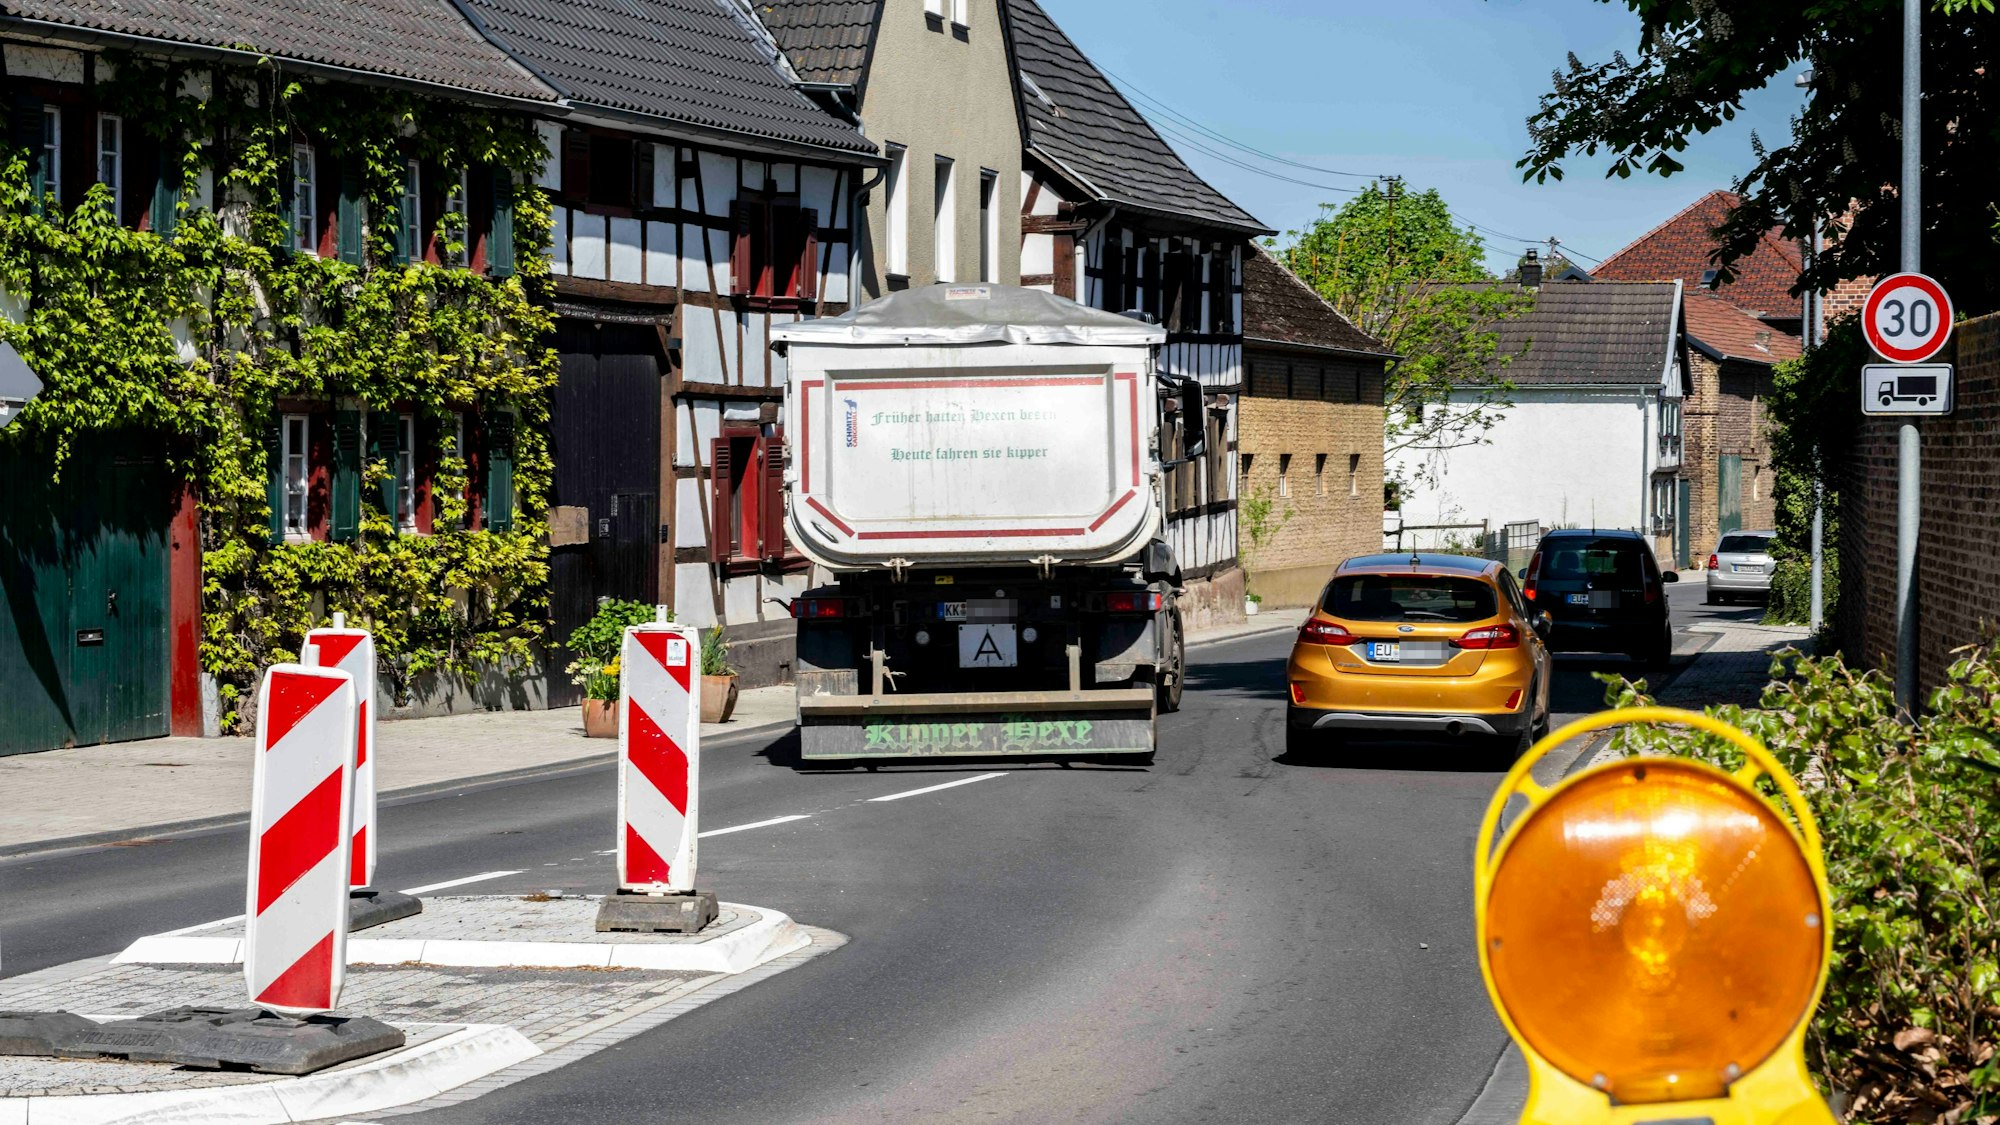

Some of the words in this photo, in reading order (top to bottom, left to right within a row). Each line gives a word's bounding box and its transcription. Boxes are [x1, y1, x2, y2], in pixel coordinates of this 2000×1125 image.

[1883, 299, 1931, 337] 30
[870, 411, 921, 426] Früher
[891, 448, 932, 462] Heute
[936, 447, 978, 462] fahren
[982, 447, 1002, 459] sie
[1006, 446, 1048, 459] kipper
[945, 604, 959, 616] KK
[974, 630, 1003, 661] A
[1376, 644, 1392, 656] EU
[864, 714, 984, 755] Kipper
[1001, 714, 1093, 753] Hexe
